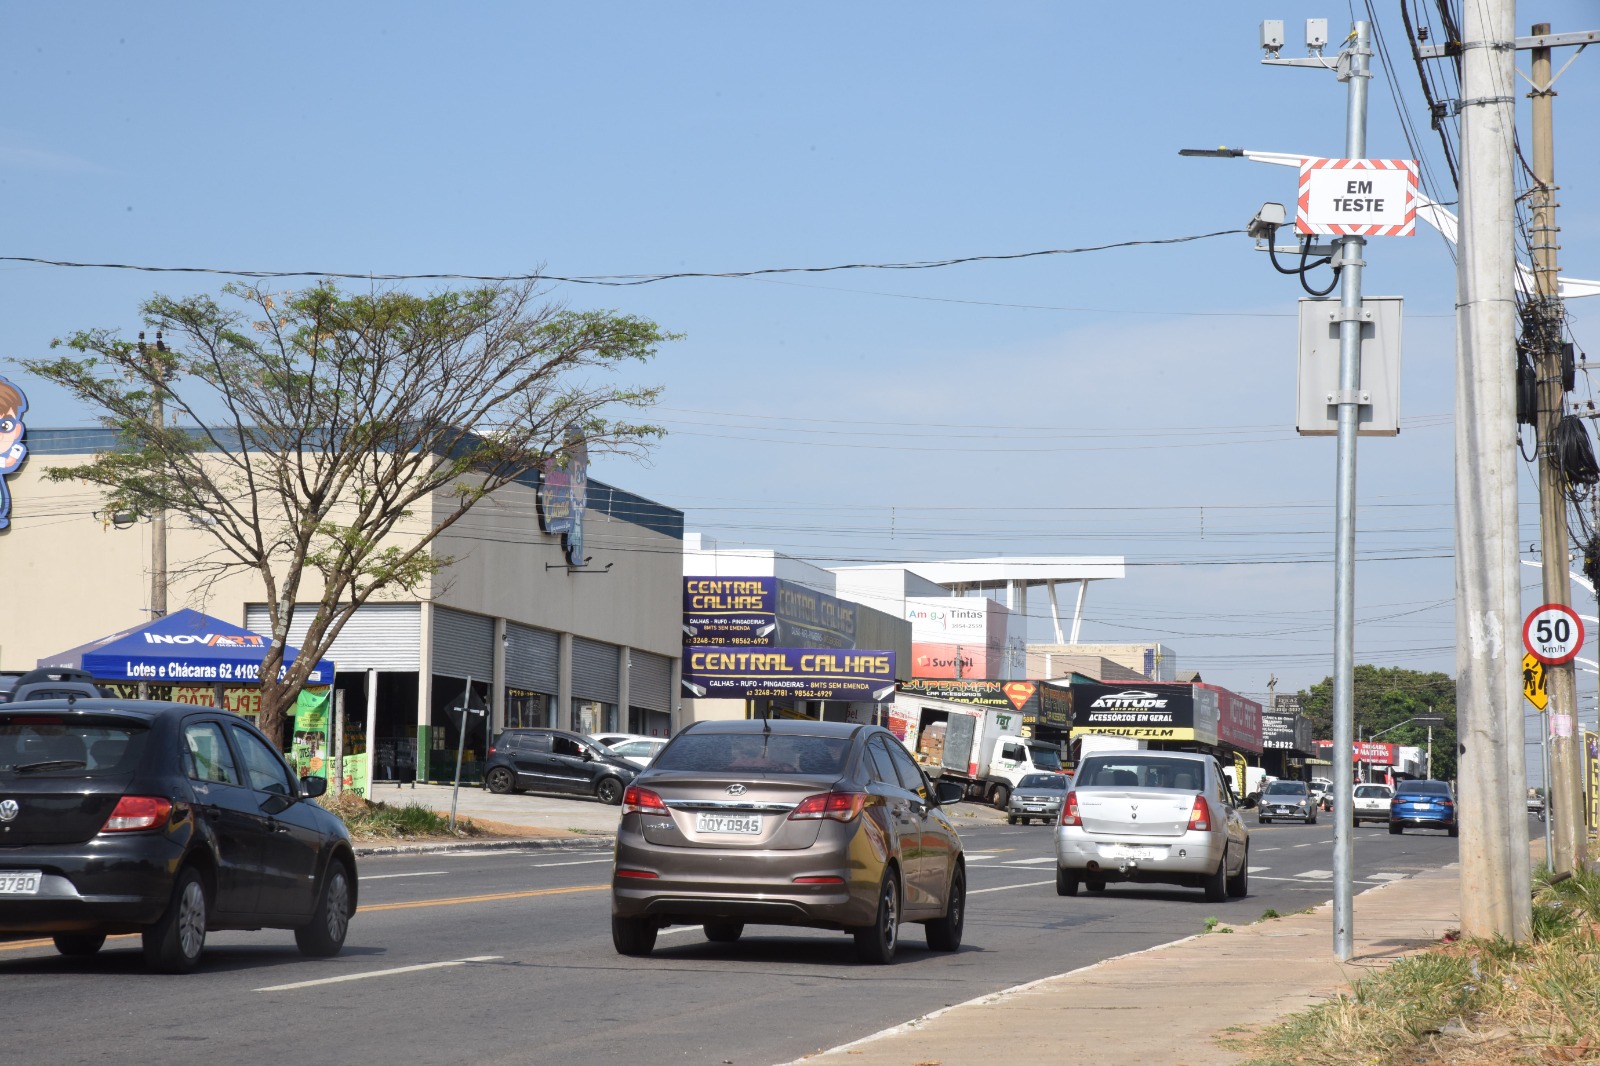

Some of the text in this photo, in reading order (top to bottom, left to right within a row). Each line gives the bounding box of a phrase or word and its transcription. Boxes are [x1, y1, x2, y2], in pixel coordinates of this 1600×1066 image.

[1347, 181, 1372, 194] EM
[1333, 199, 1384, 212] TESTE
[687, 581, 768, 595] CENTRAL
[692, 596, 763, 609] CALHAS
[950, 610, 983, 619] Tintas
[1536, 619, 1571, 643] 50
[692, 637, 726, 645] 3248-2781
[731, 637, 769, 645] 98562-6929
[1542, 645, 1566, 653] km/h
[127, 661, 156, 677] Lotes
[159, 665, 166, 677] e
[168, 662, 217, 678] Chácaras
[219, 663, 233, 679] 62
[691, 653, 890, 675] CENTRAL CALHAS
[709, 680, 735, 688] CALHAS
[763, 681, 805, 689] PINGADEIRAS
[901, 680, 1001, 693] SUPERMAN
[754, 689, 788, 697] 3248-2781
[794, 690, 833, 698] 98562-6929
[1090, 699, 1168, 708] ATITUDE
[1088, 712, 1173, 722] ACESSÓRIOS EM GERAL
